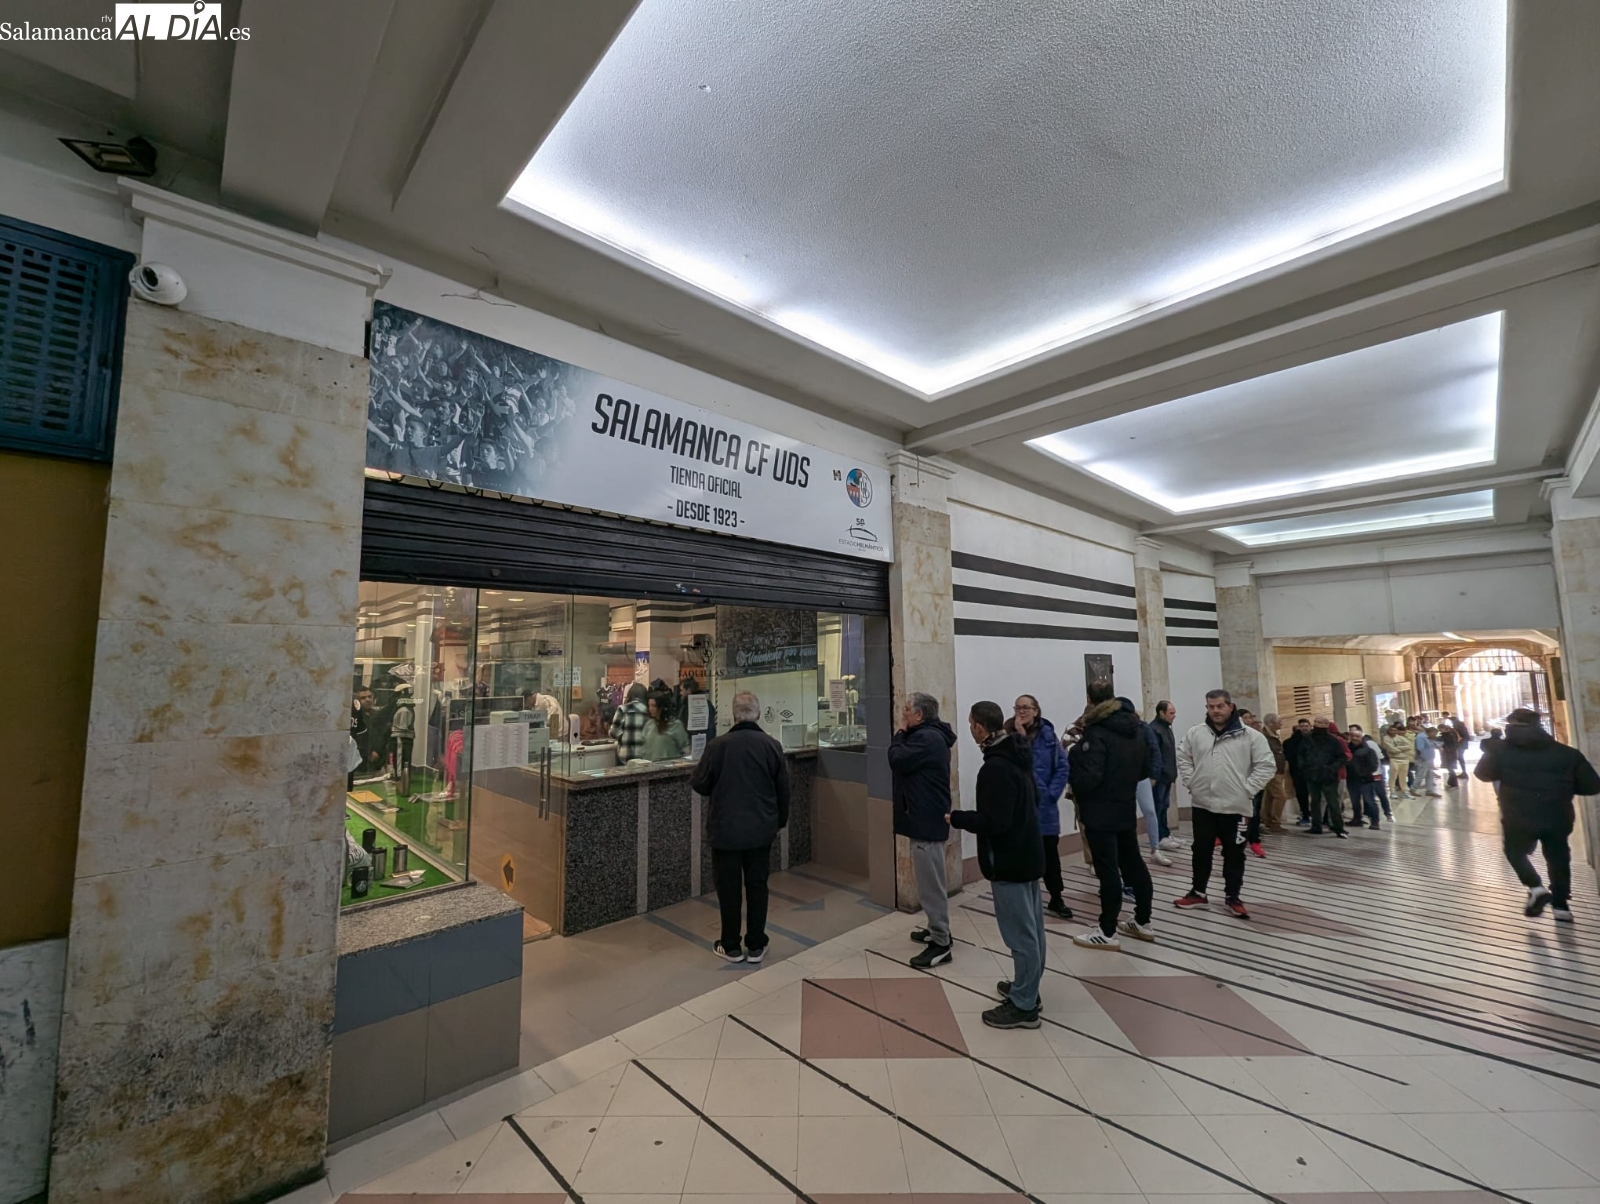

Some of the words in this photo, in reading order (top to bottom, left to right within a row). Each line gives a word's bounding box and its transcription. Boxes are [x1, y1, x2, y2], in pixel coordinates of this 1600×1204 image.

[591, 393, 742, 470] SALAMANCA
[744, 440, 771, 477] CF
[773, 447, 811, 489] UDS
[670, 465, 706, 491] TIENDA
[707, 475, 742, 499] OFICIAL
[676, 499, 711, 523] DESDE
[713, 507, 738, 528] 1923
